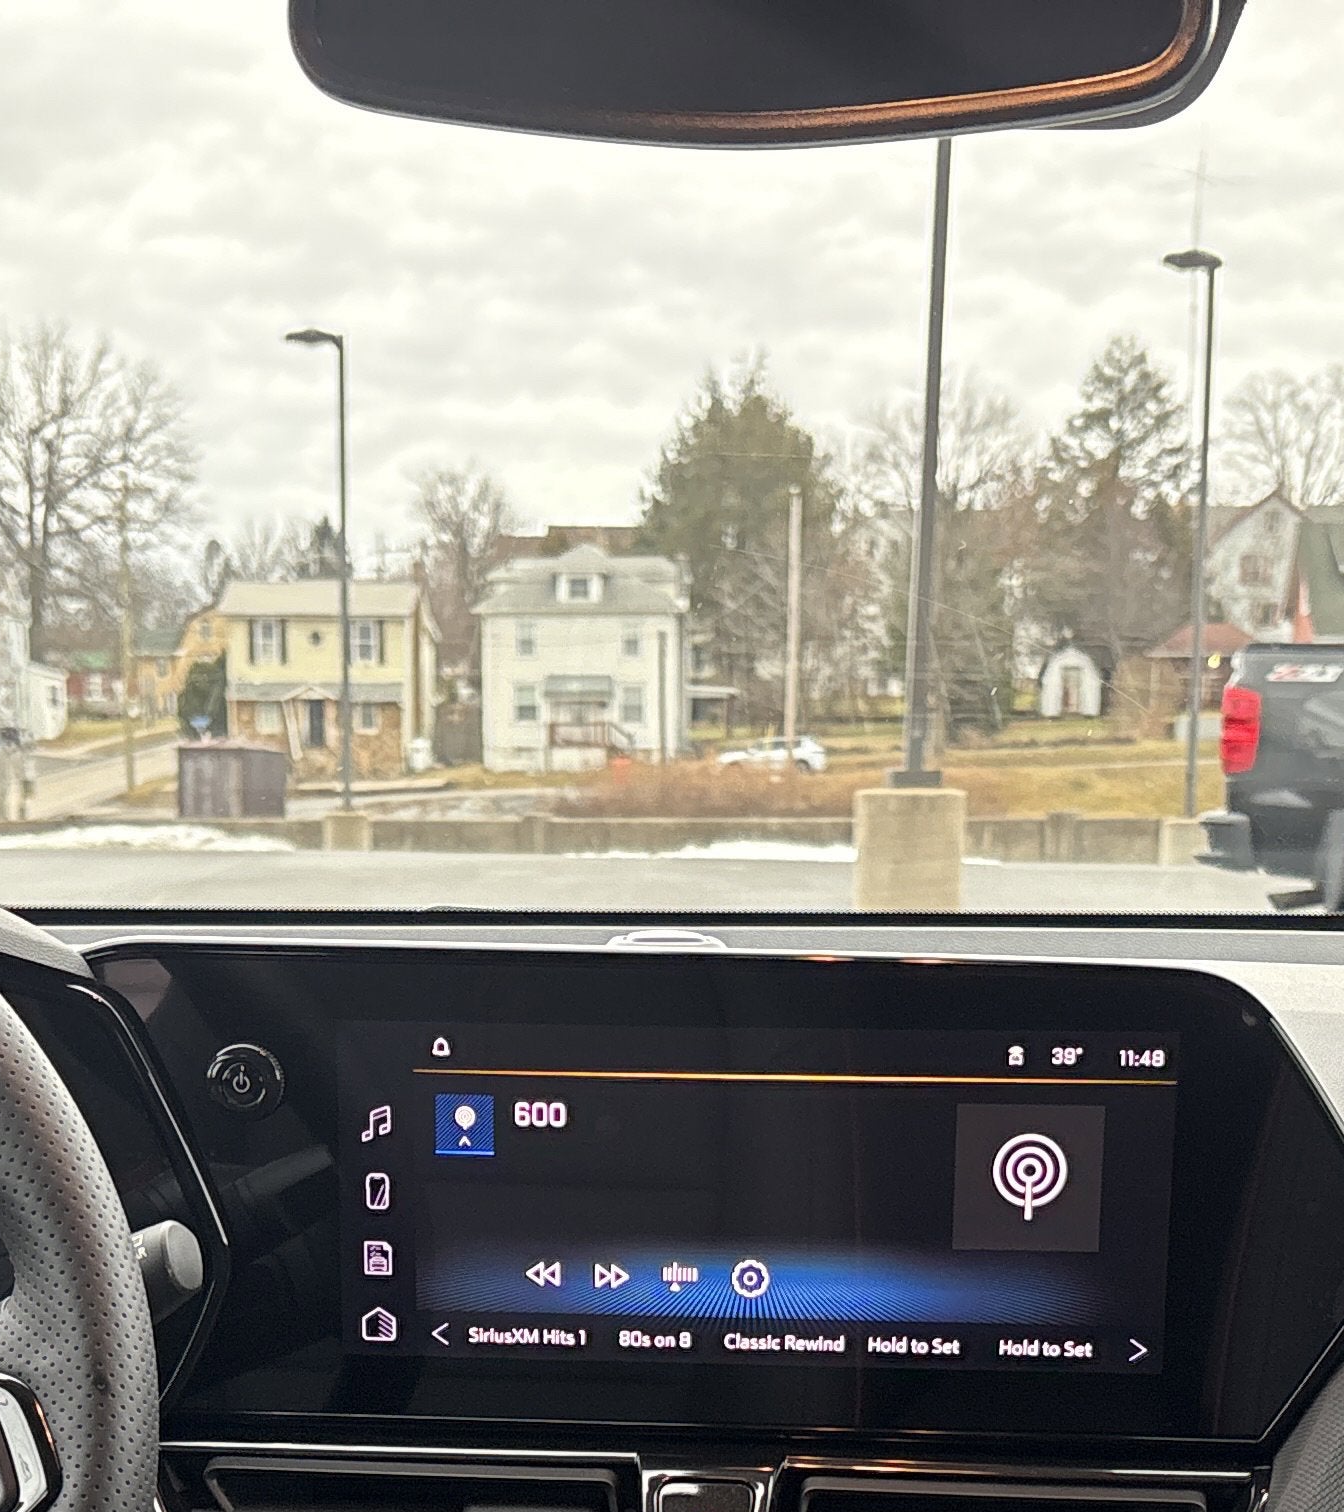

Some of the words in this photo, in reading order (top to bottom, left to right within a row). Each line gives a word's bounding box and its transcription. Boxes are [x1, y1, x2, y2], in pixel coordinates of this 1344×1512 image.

[1052, 1047, 1083, 1066] 39°
[1120, 1049, 1165, 1067] 11:48
[514, 1101, 567, 1128] 600
[468, 1327, 539, 1344] SiriusXM
[542, 1329, 575, 1346] Hits
[578, 1330, 587, 1346] 1
[618, 1330, 651, 1347] 80s
[653, 1334, 676, 1348] on
[679, 1332, 691, 1348] 8
[723, 1333, 781, 1351] Classic
[784, 1335, 845, 1352] Rewind
[867, 1337, 908, 1353] Hold
[910, 1338, 928, 1354] to
[931, 1338, 960, 1355] Set
[999, 1340, 1038, 1356] Hold
[1041, 1341, 1060, 1357] to
[1063, 1341, 1093, 1357] Set
